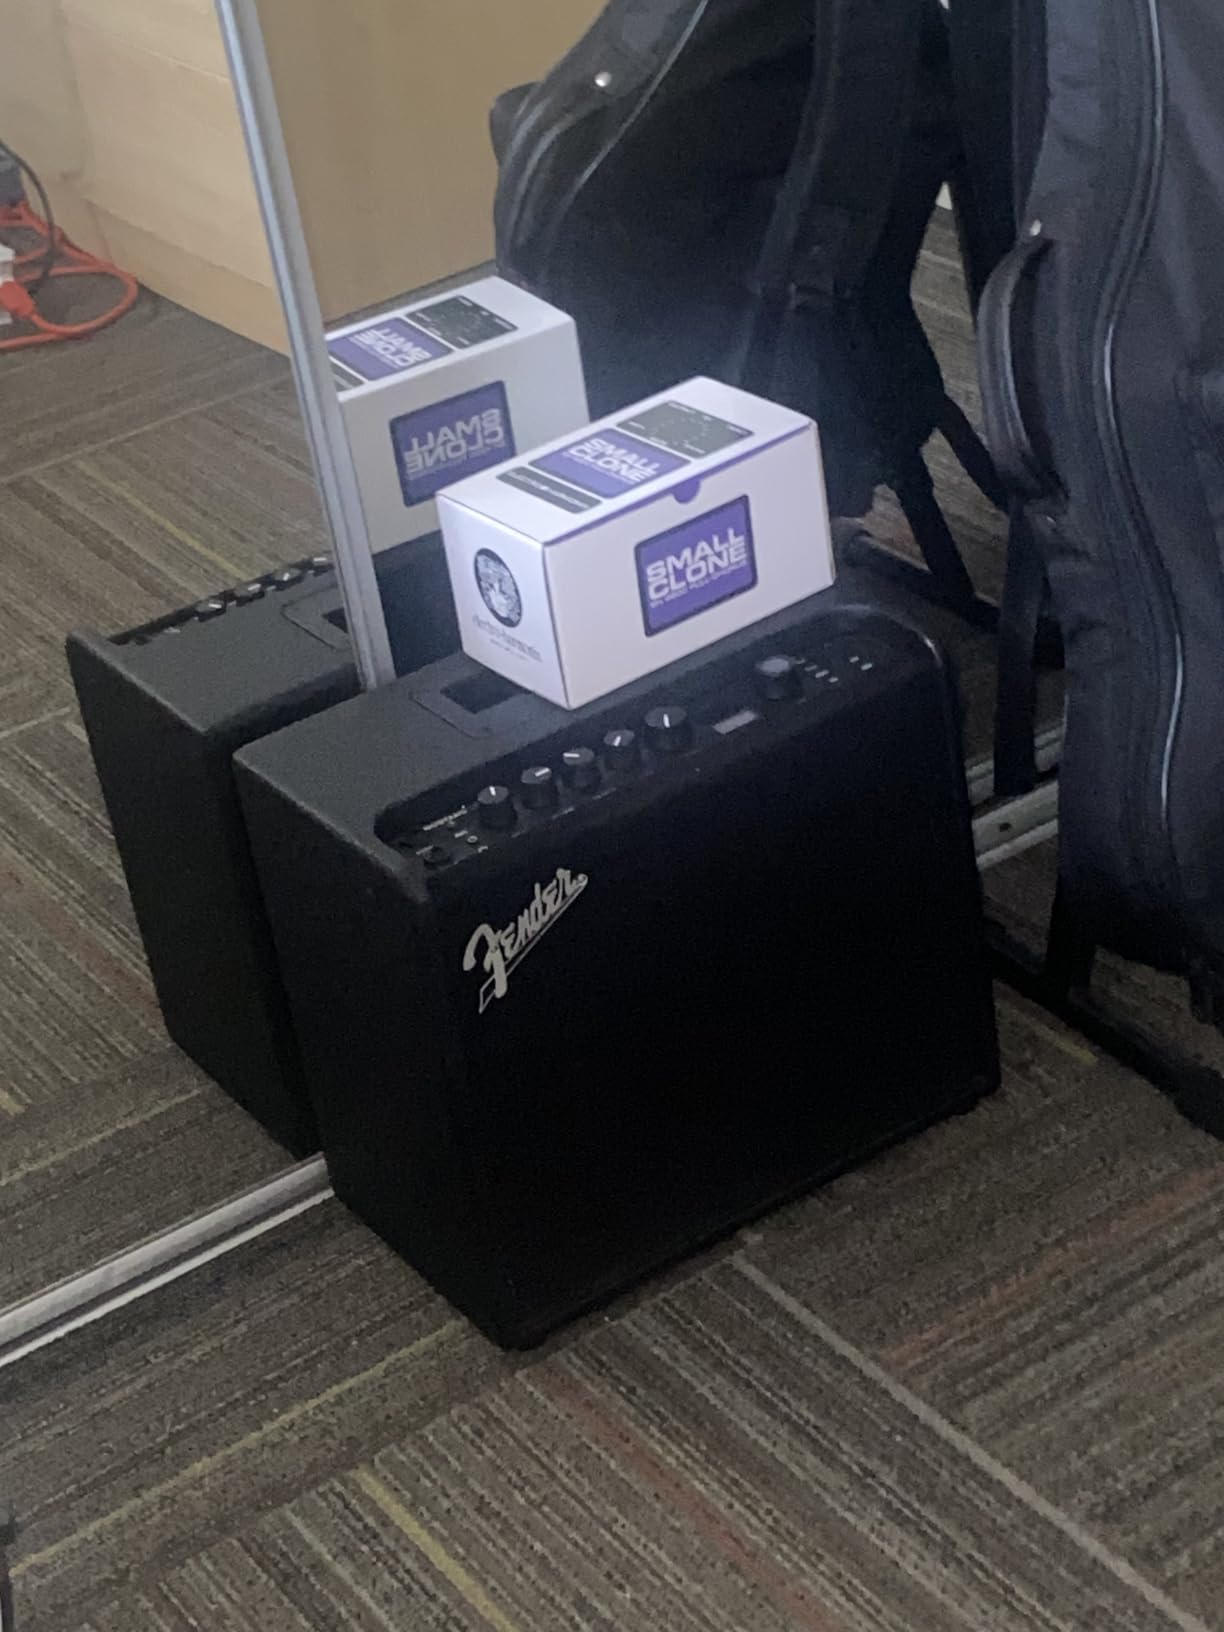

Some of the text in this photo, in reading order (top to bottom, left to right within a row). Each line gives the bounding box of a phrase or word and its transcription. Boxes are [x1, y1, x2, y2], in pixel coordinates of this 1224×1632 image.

[569, 445, 651, 482] CLONE
[583, 437, 660, 474] SMALL
[646, 527, 745, 582] SMALL
[648, 543, 747, 600] CLONE
[463, 867, 588, 1000] Fender
